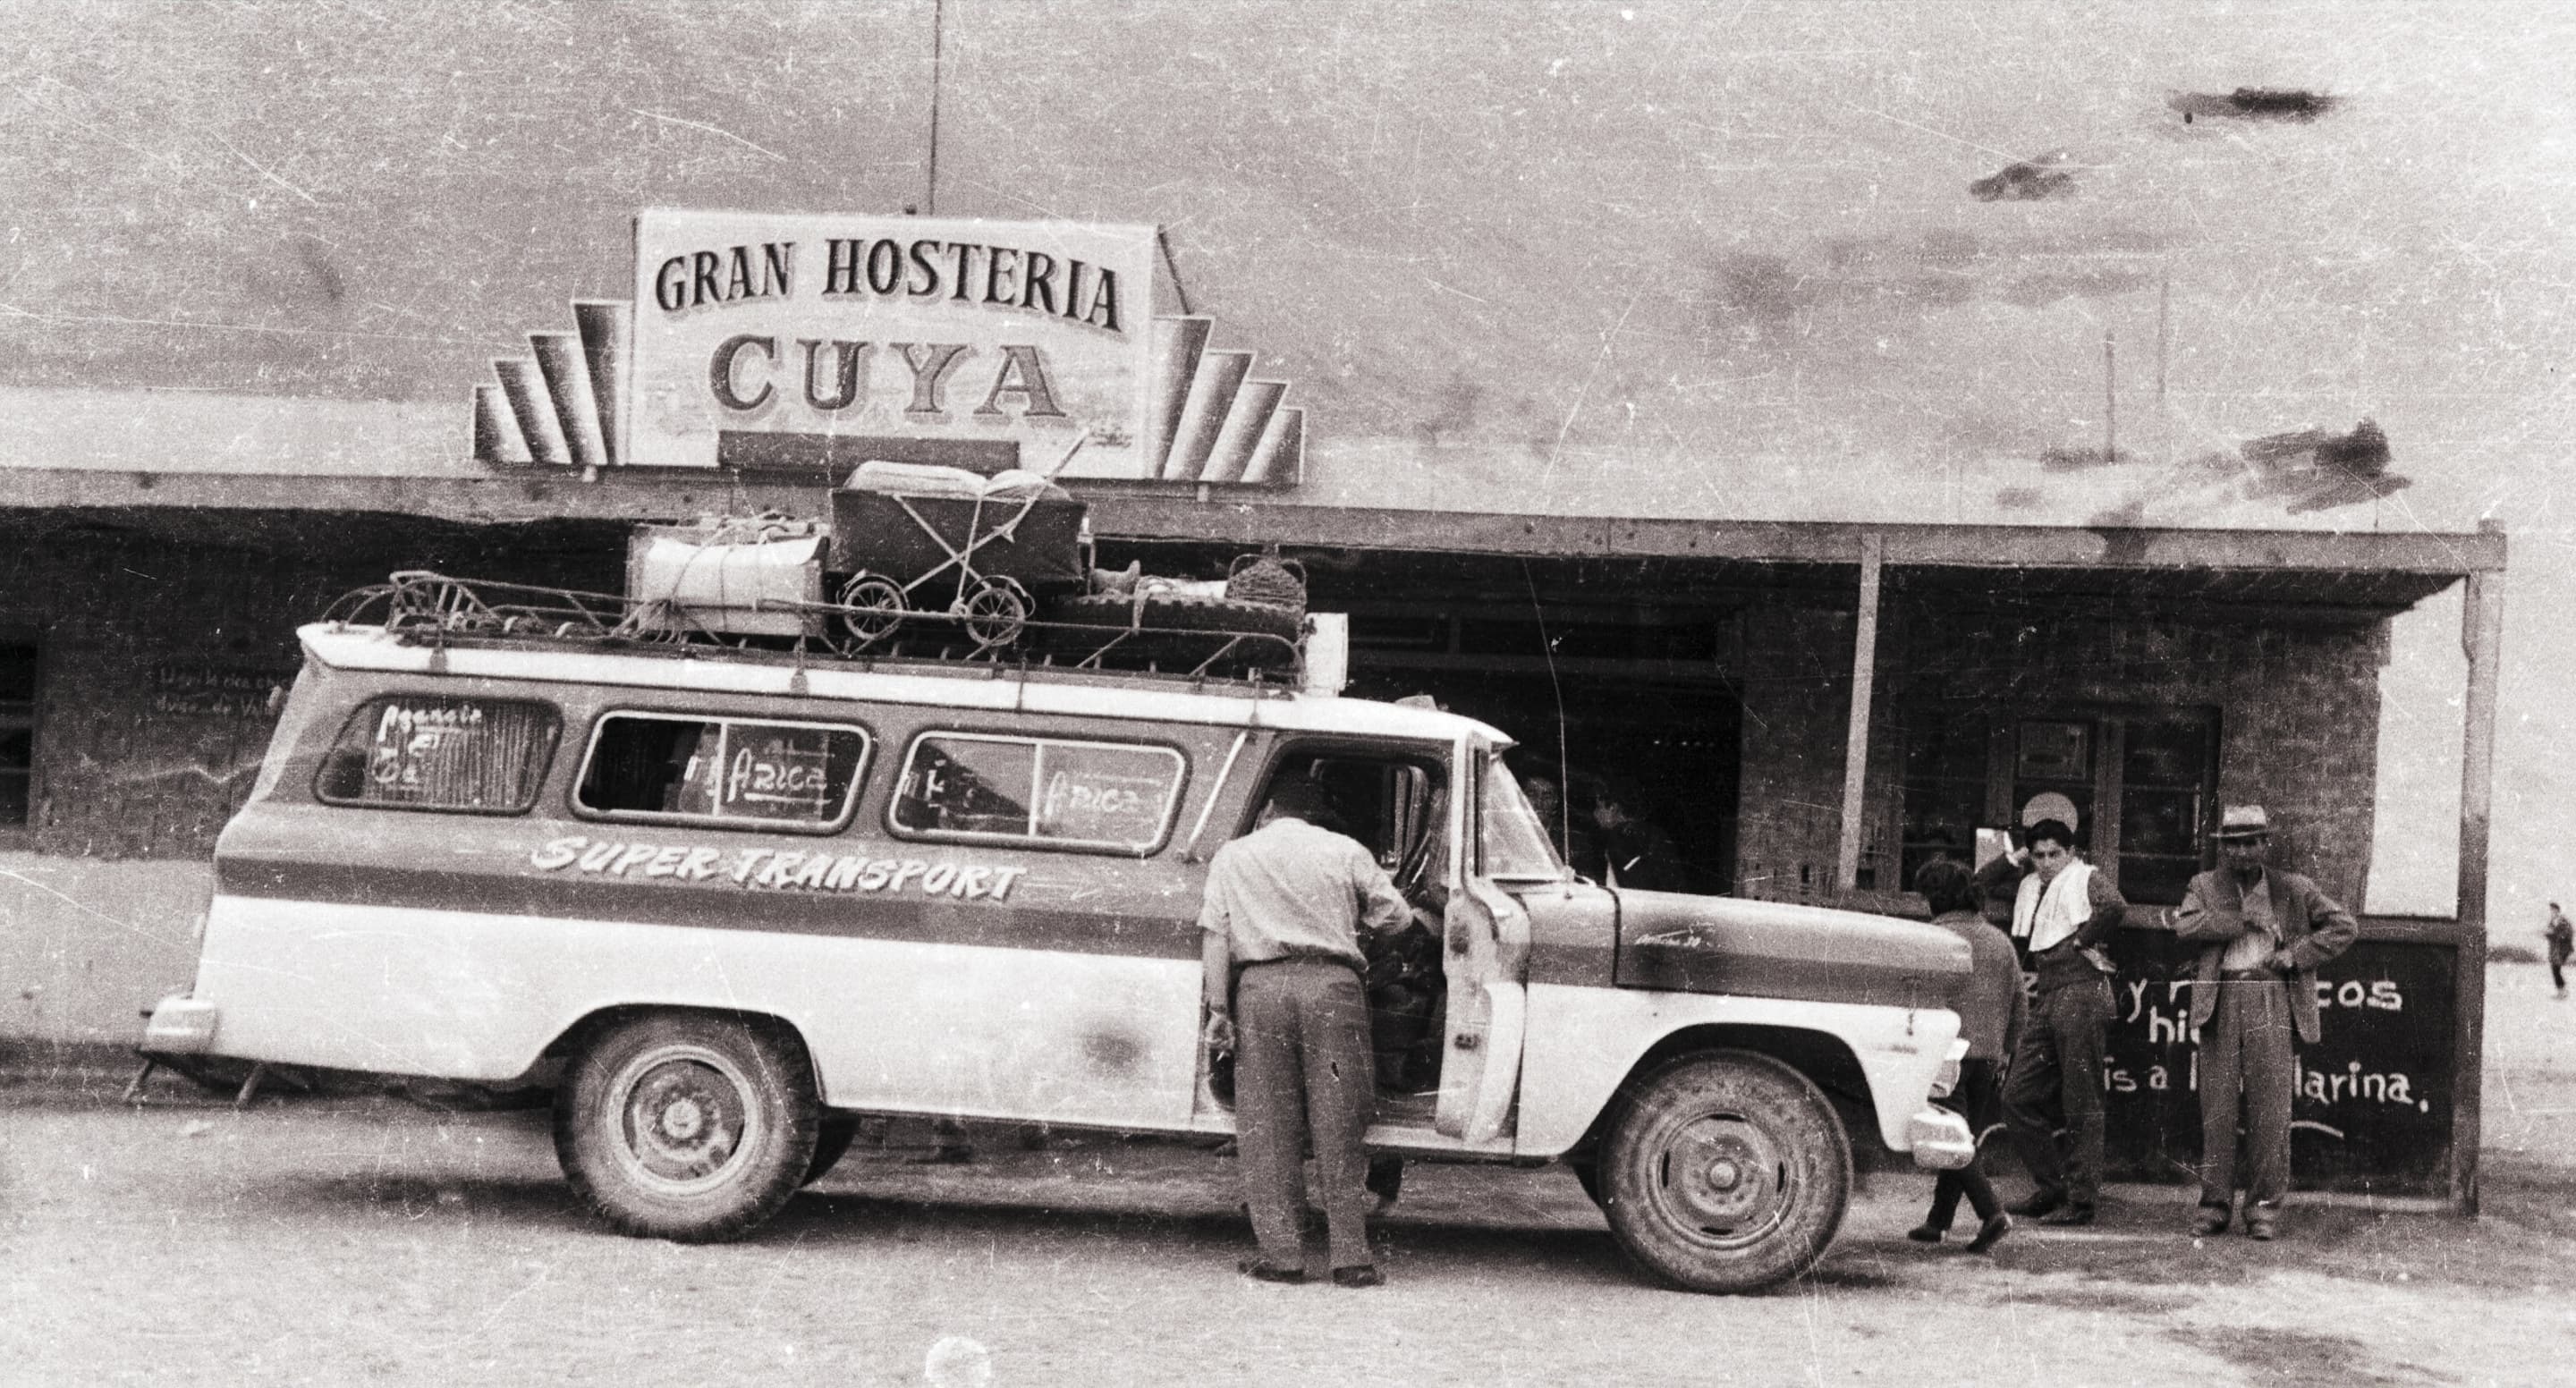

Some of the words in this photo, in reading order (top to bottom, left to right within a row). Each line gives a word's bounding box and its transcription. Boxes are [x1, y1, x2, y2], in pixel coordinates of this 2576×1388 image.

[655, 241, 797, 313] GRAN
[821, 238, 1125, 333] HOSTERIA
[709, 334, 1070, 420] CUYA
[530, 835, 721, 881] SUPER
[731, 848, 1028, 902] TRANSPORT
